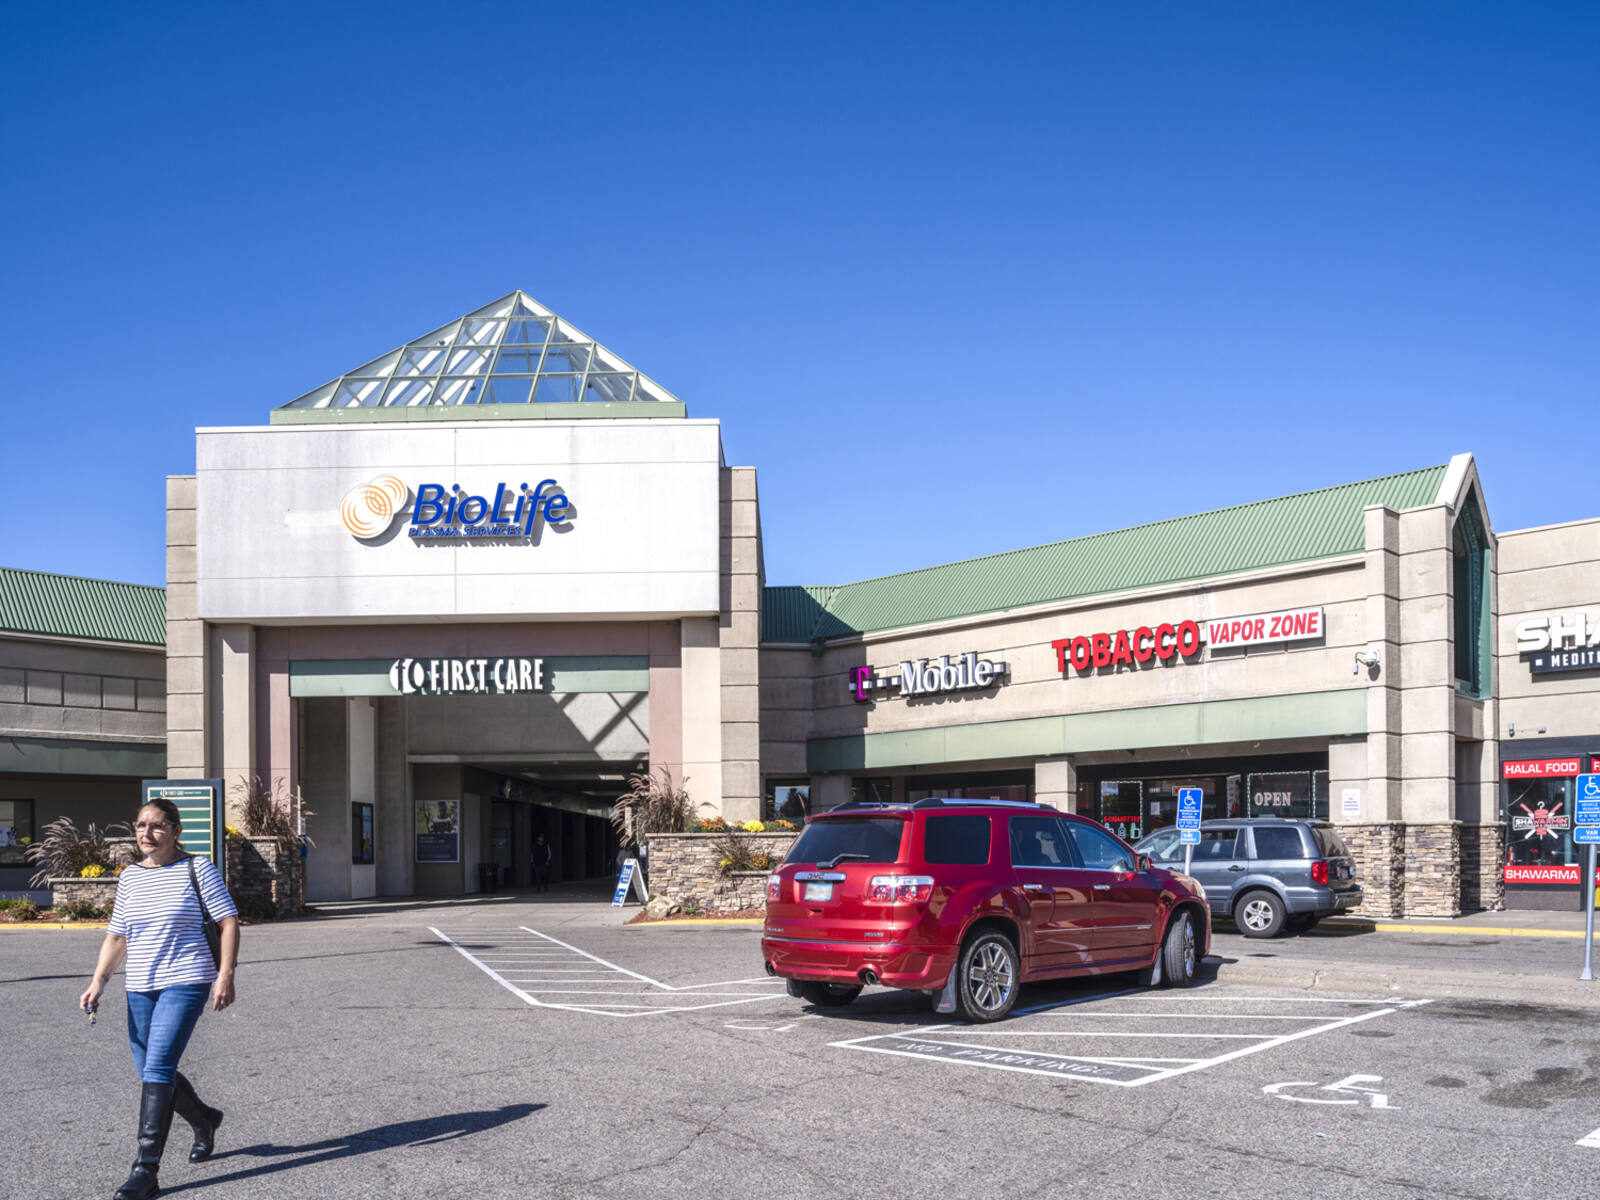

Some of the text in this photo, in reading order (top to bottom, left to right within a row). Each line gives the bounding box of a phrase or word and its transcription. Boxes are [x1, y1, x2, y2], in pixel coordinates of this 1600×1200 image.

[410, 479, 569, 536] BioLife
[408, 525, 521, 537] PLASMA SERVICES
[1210, 611, 1319, 645] VAPOR ZONE
[1051, 619, 1200, 673] TOBACCO
[430, 659, 488, 691] FIRST
[494, 658, 544, 690] CARE
[1505, 762, 1578, 774] HALAL FOOD
[1254, 792, 1291, 806] OPEN
[1505, 870, 1579, 880] SHAWARMA
